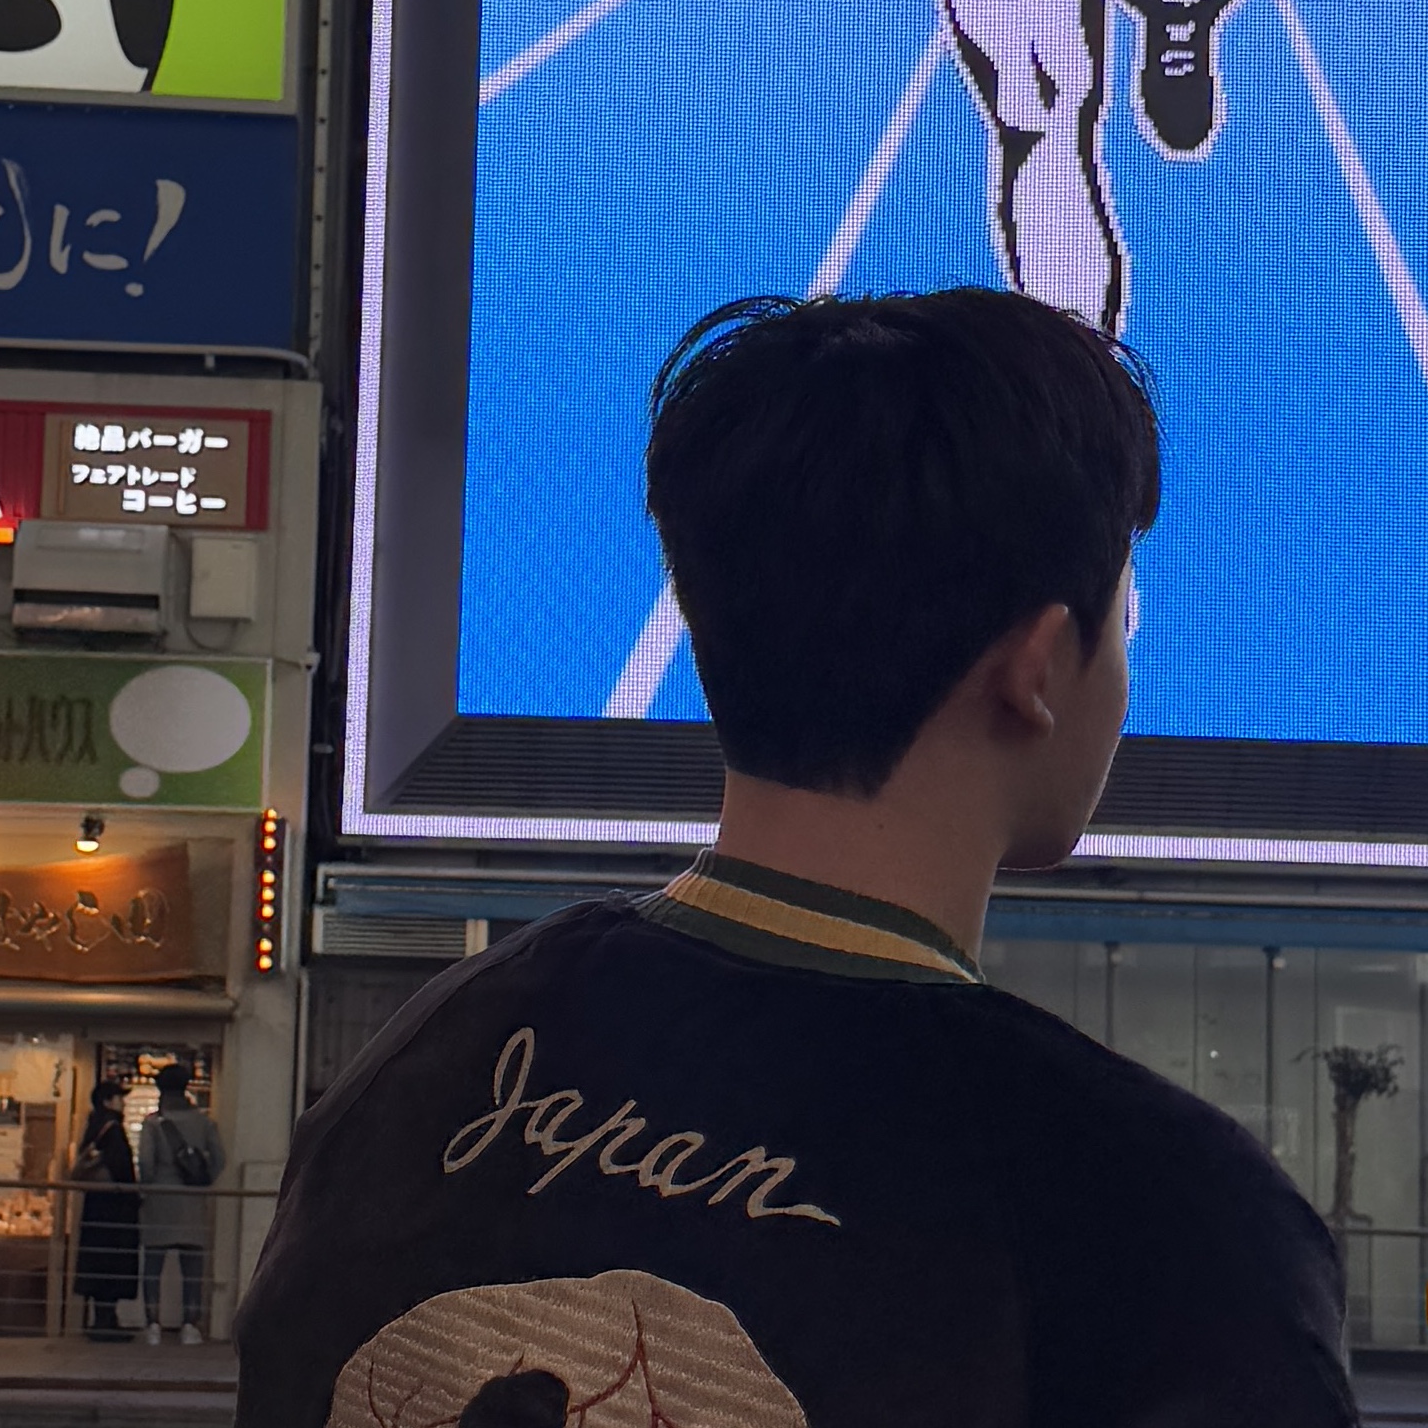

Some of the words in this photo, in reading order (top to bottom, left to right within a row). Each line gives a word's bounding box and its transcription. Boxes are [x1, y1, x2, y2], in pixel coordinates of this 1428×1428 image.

[71, 463, 197, 489] フェアトレード
[121, 488, 227, 516] コーヒー
[441, 1026, 843, 1228] Japan
